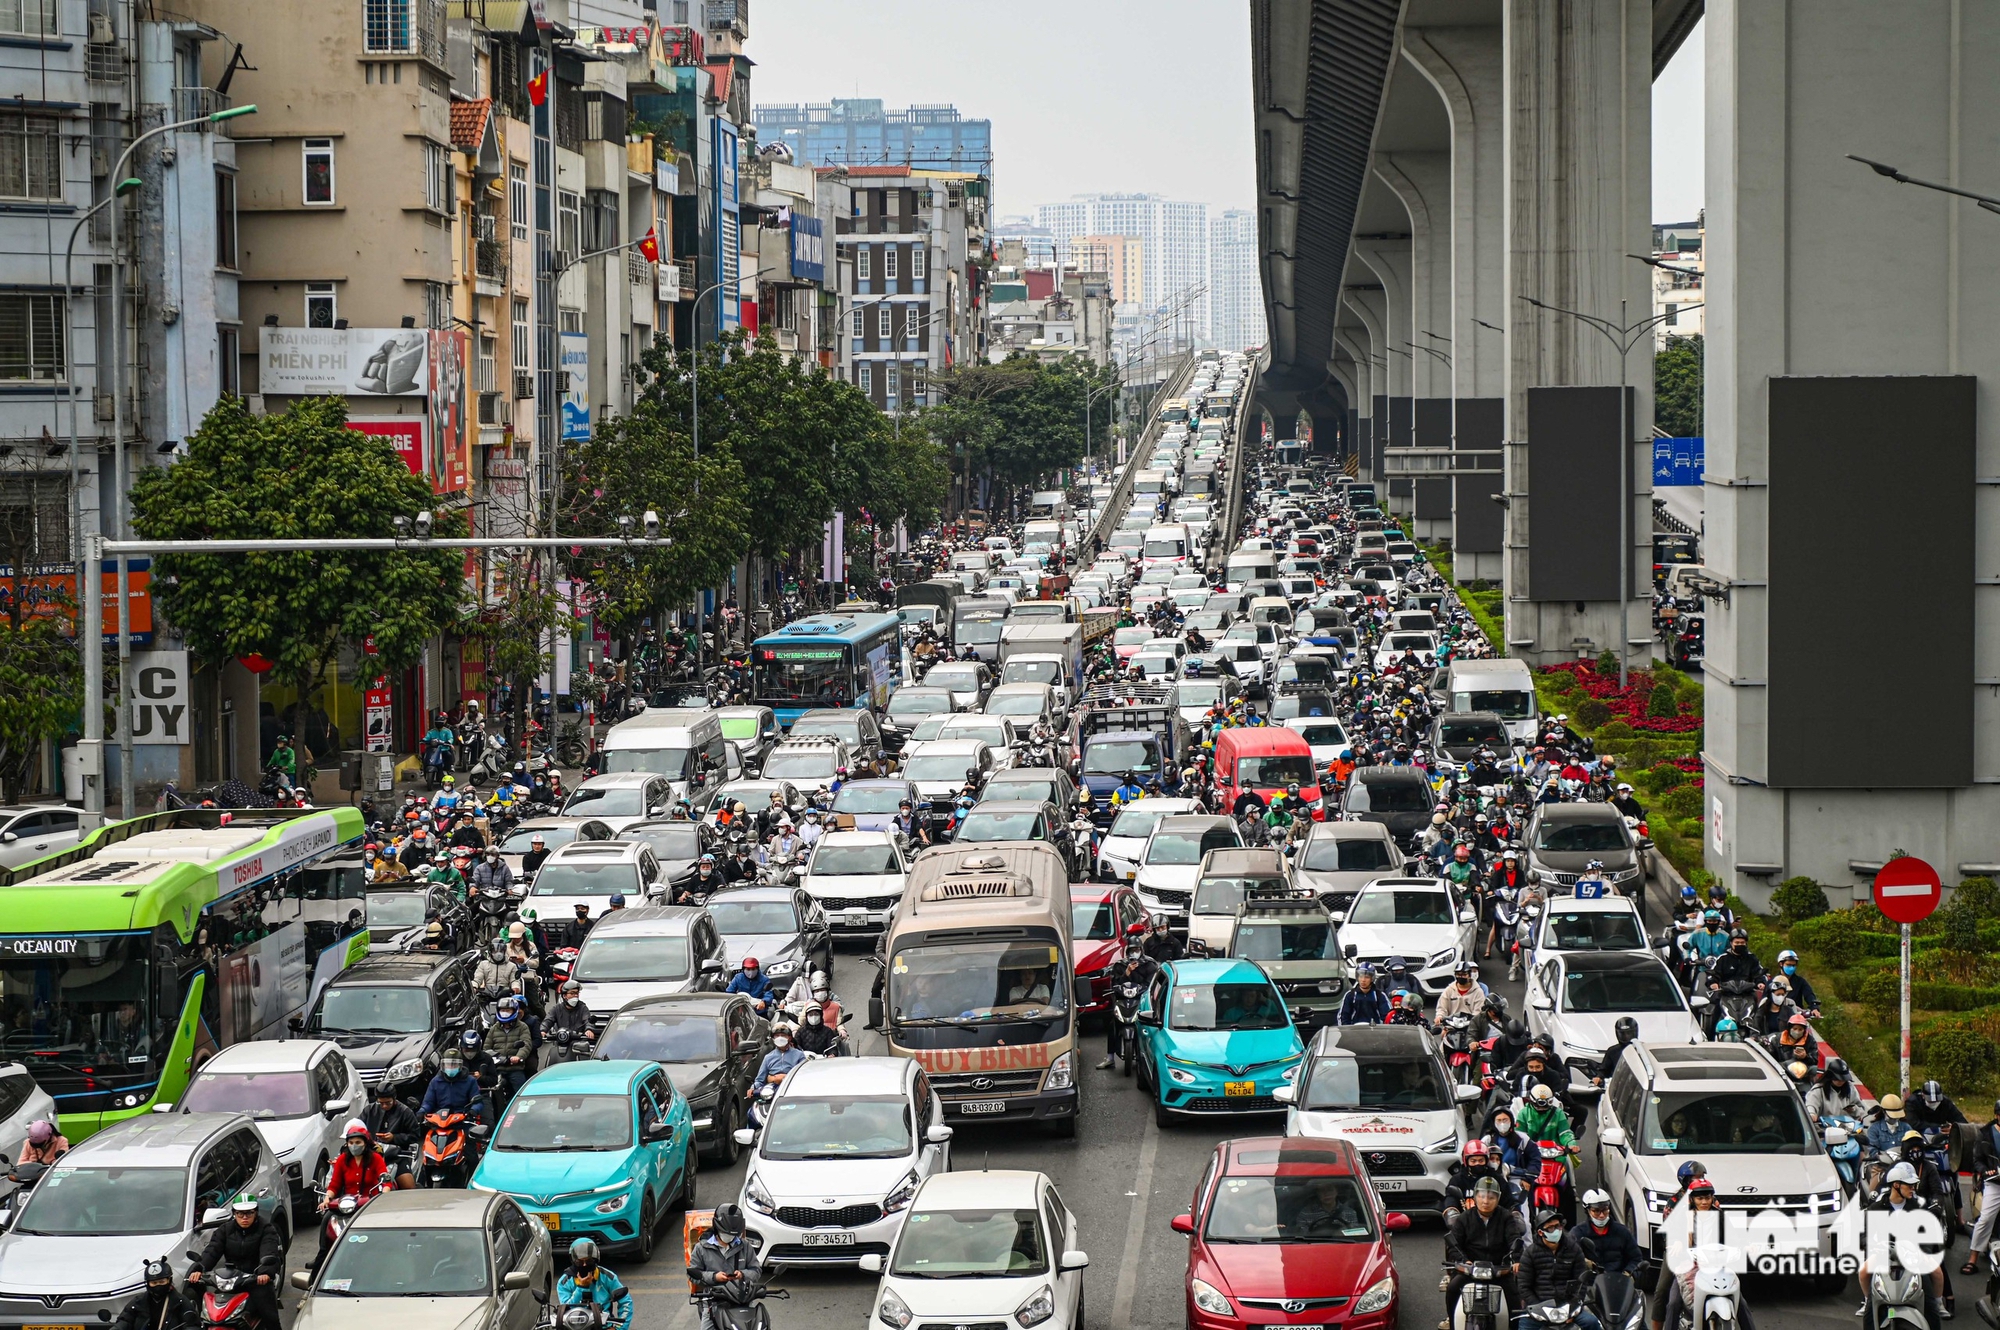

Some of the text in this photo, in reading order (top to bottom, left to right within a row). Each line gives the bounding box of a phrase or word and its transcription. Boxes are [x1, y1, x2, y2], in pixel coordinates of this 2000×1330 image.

[269, 346, 348, 370] MIỄN PHÍ
[371, 696, 380, 704] XA
[233, 857, 263, 885] TOSHIBA
[14, 940, 53, 954] OCEAN
[54, 939, 78, 953] CITY
[914, 1038, 1051, 1073] HUY BÌNH
